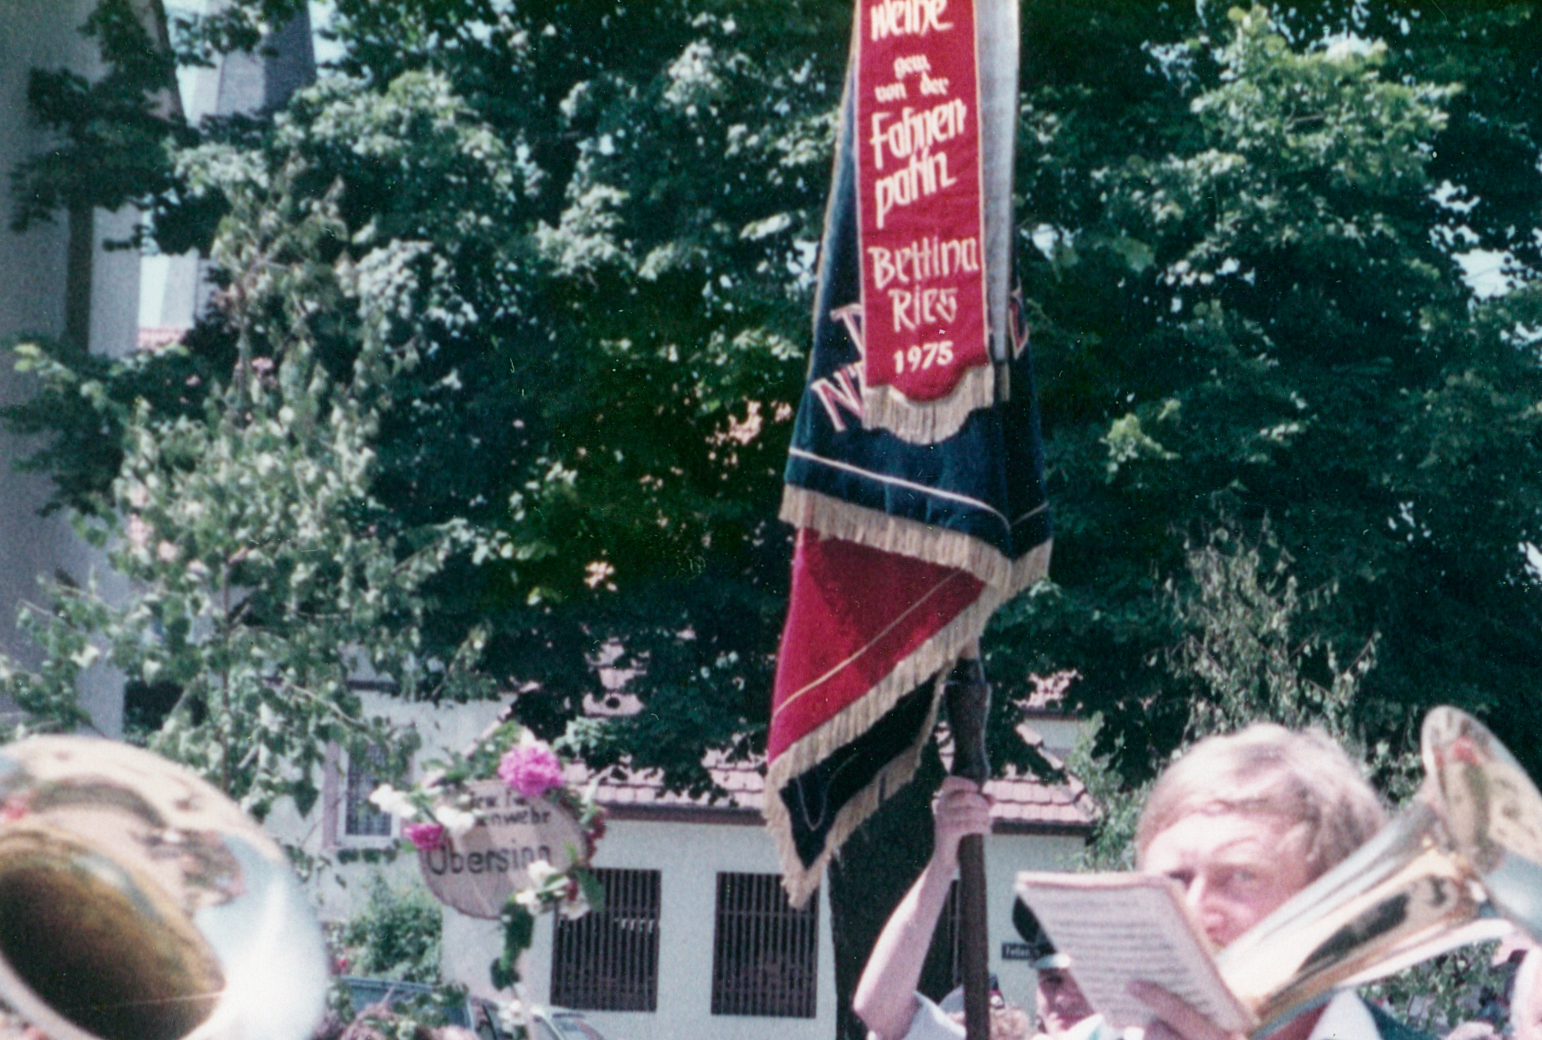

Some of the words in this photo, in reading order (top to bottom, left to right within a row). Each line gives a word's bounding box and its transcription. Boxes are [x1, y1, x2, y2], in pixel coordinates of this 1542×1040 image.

[874, 82, 907, 103] von
[920, 71, 949, 95] der
[869, 98, 967, 170] Fahnen
[875, 147, 957, 230] patin
[867, 237, 979, 290] Bettina
[887, 285, 958, 333] Ries
[893, 340, 954, 374] 1975
